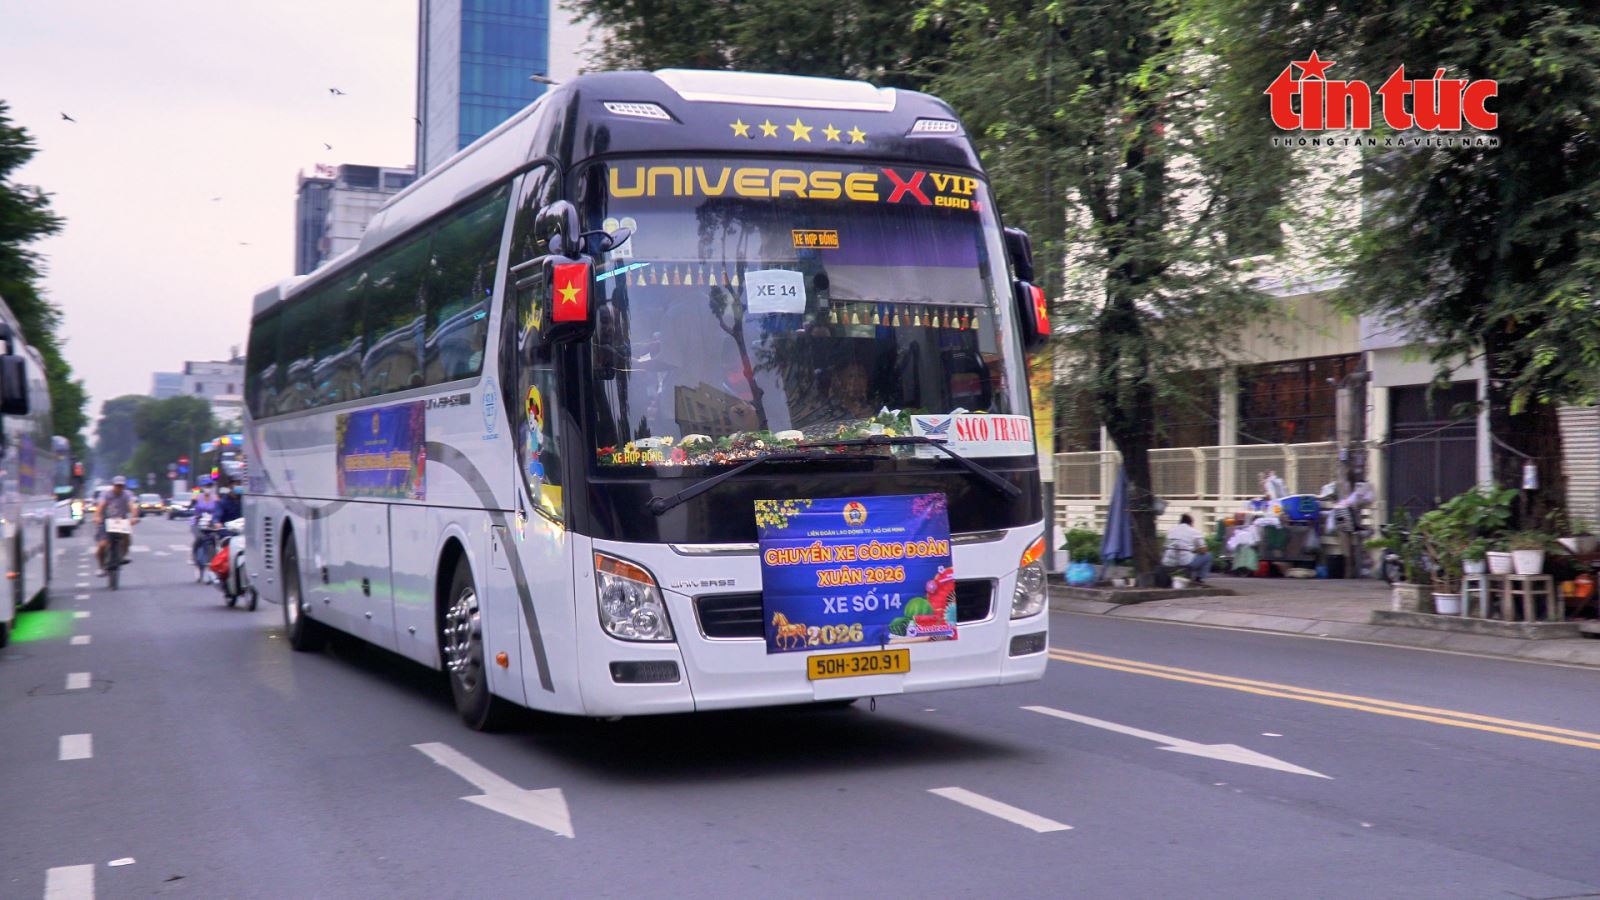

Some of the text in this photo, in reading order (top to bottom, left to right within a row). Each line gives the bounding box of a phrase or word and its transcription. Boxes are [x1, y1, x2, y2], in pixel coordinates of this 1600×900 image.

[610, 166, 979, 206] UNIVERSE X VIP
[794, 233, 803, 245] XE
[757, 284, 797, 297] XE 14
[956, 416, 989, 442] SACO
[612, 452, 623, 464] XE
[764, 536, 950, 566] CHUYẾN XE CÔNG ĐOÀN
[816, 564, 906, 588] XUÂN 2026
[823, 587, 902, 615] XE SỐ 14
[807, 623, 865, 647] 2026
[816, 654, 901, 676] 50H-320.91
